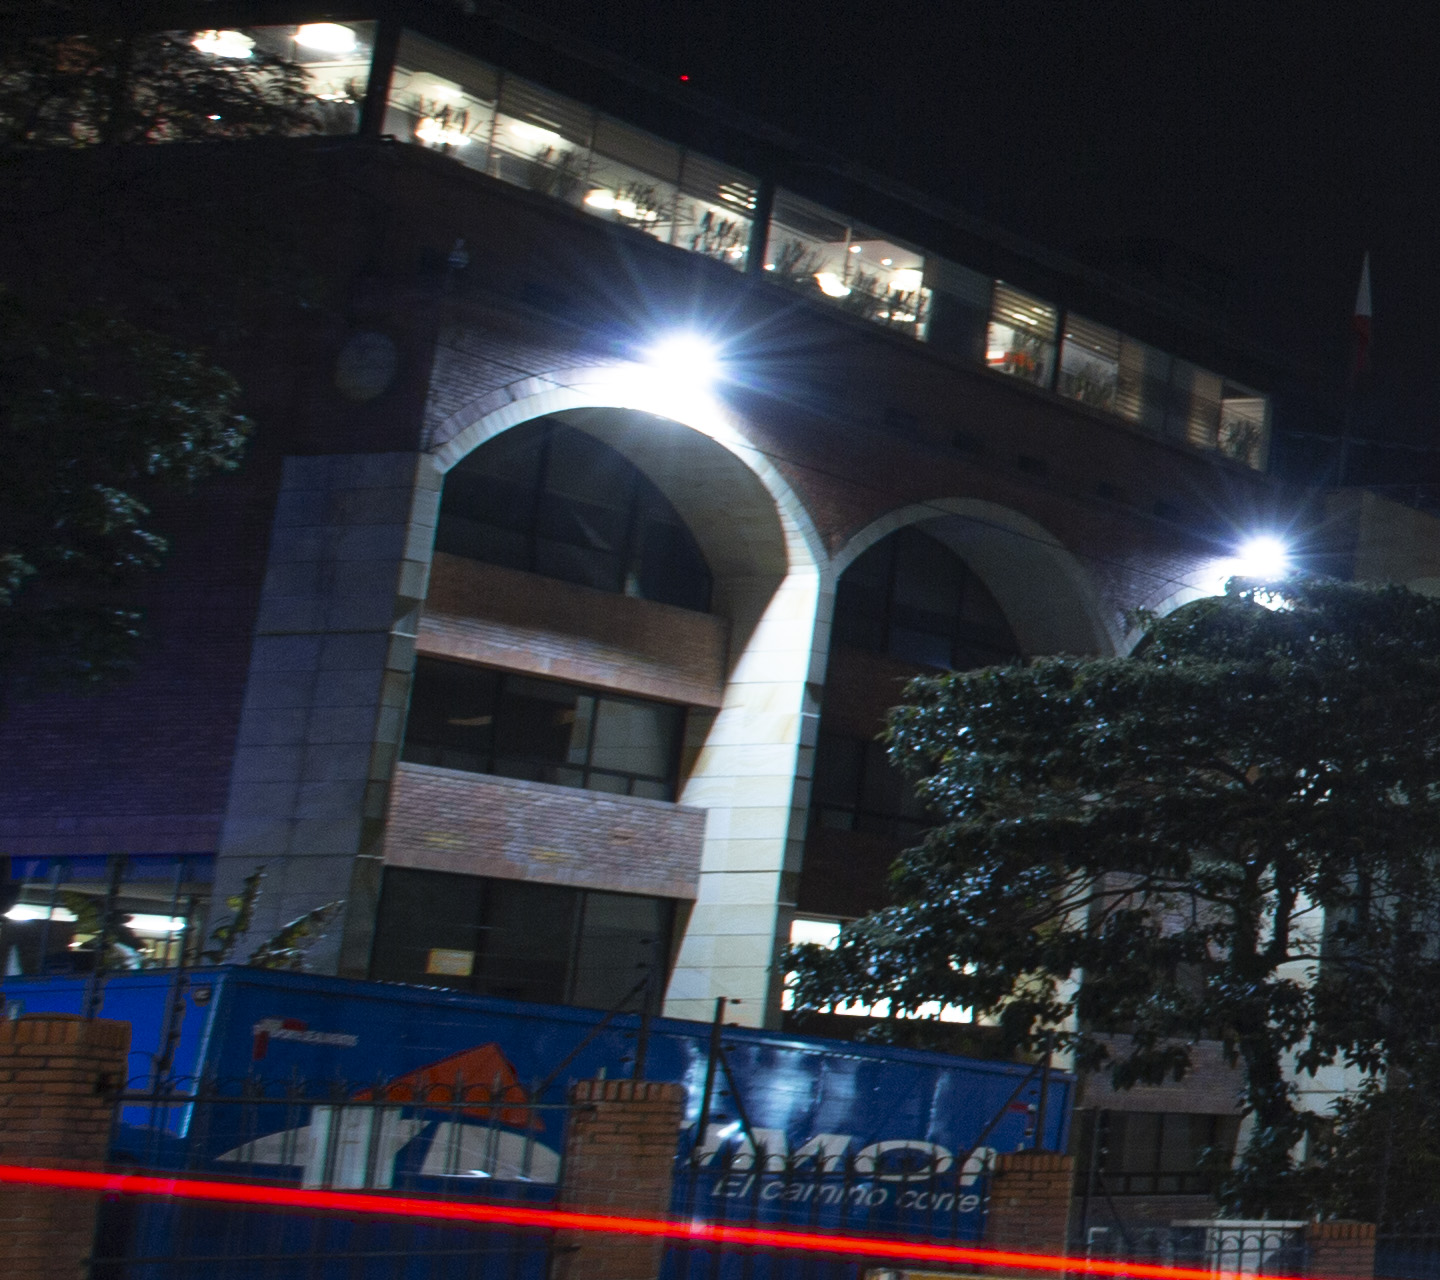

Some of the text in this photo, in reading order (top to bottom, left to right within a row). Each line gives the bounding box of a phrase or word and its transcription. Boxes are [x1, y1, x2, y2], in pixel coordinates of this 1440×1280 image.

[711, 1172, 992, 1215] El camino corre
